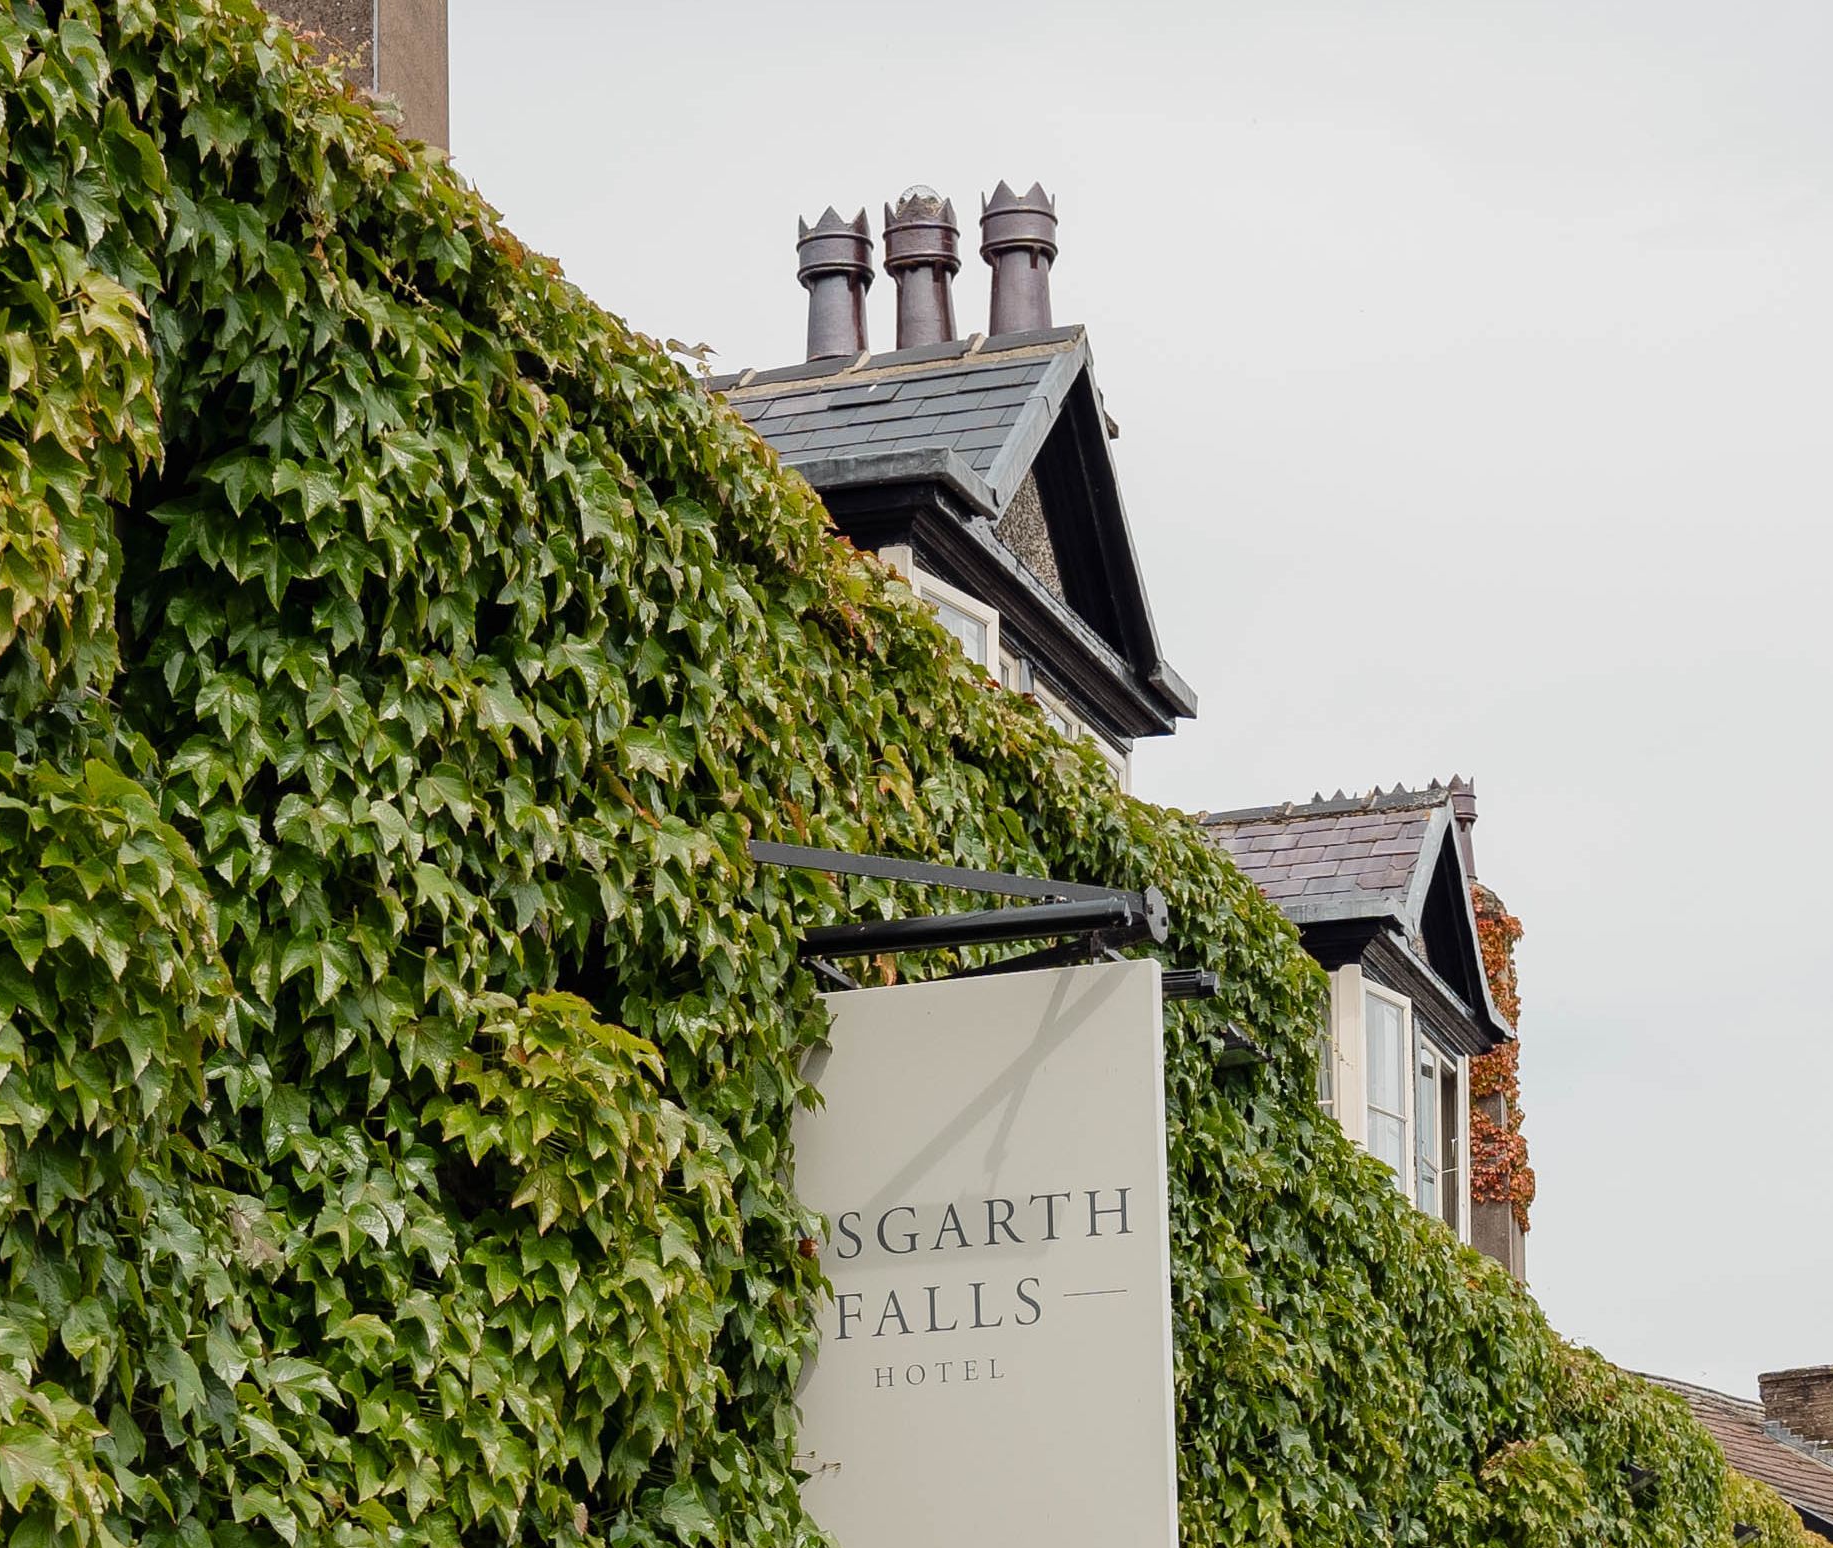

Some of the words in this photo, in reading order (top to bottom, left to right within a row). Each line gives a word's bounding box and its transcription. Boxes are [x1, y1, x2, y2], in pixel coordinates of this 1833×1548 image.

[796, 1187, 1134, 1259] SGARTH
[834, 1277, 1043, 1340] FALLS
[873, 1358, 1005, 1389] HOTEL
